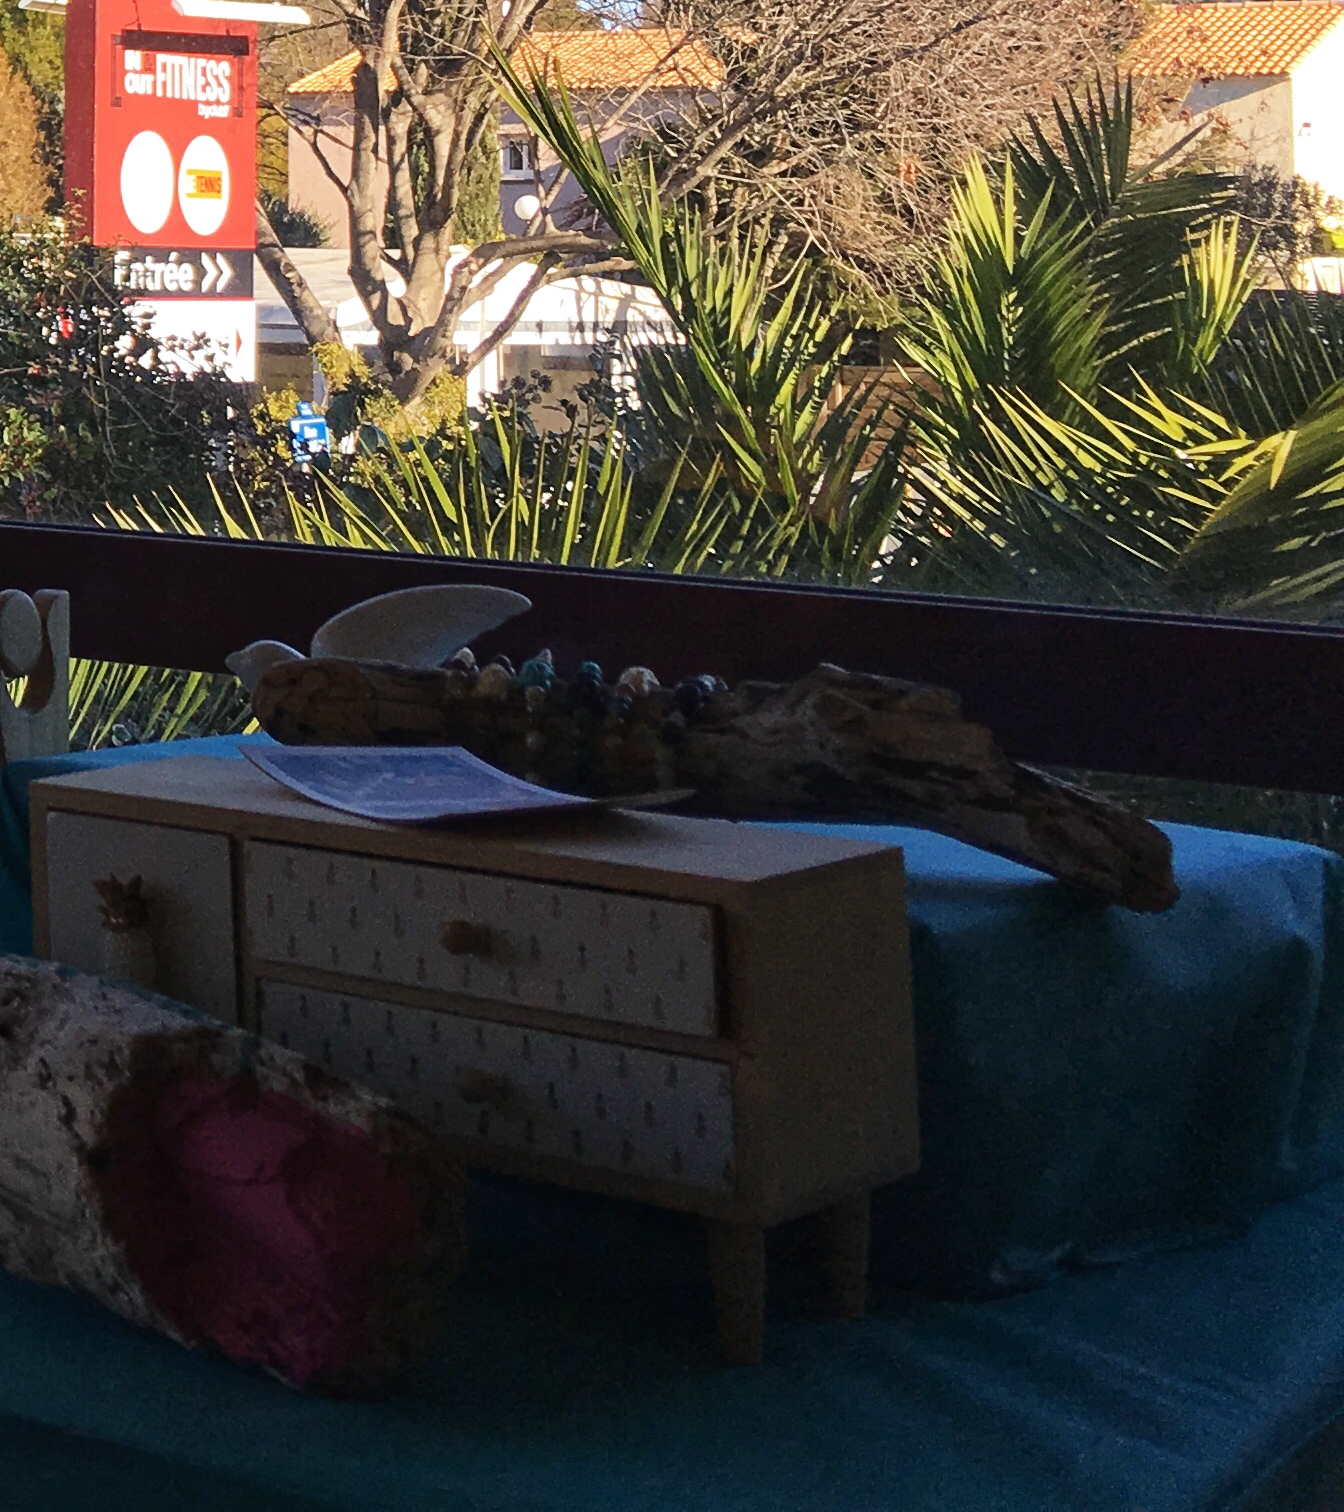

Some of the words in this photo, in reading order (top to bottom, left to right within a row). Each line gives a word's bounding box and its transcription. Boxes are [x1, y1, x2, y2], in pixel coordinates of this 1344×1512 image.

[124, 49, 141, 71] IN
[124, 72, 154, 95] OUT
[155, 53, 231, 103] FITNESS
